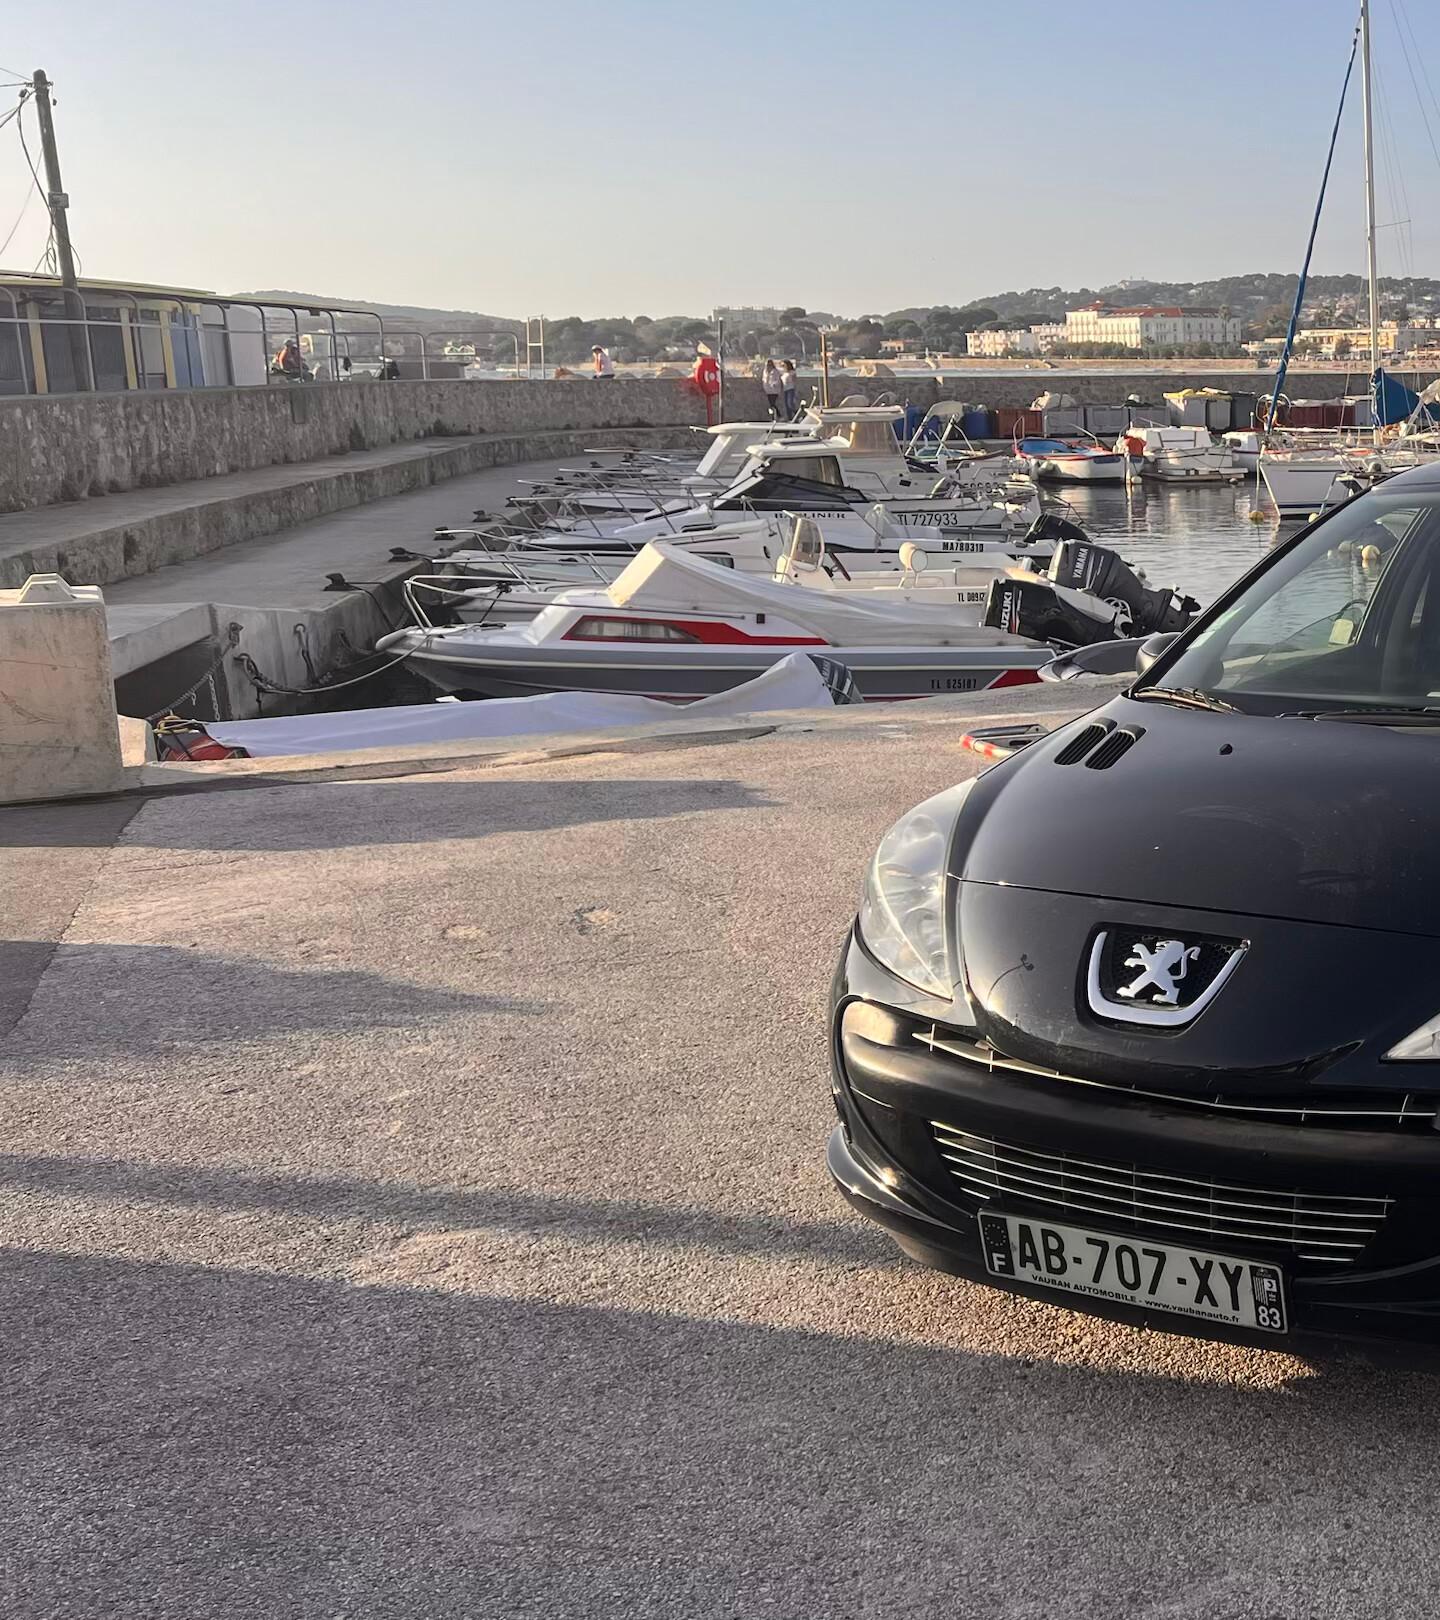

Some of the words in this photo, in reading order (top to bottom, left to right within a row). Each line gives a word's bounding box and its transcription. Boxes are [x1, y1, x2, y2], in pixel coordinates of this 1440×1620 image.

[1072, 547, 1089, 579] YAMAHA
[992, 1252, 1006, 1272] F
[1018, 1223, 1244, 1311] AB-707-XY
[1031, 1274, 1071, 1289] VAUBAN
[1073, 1284, 1137, 1303] AUTOMOBILE
[1145, 1299, 1241, 1323] www.vaubanauto.fr
[1258, 1305, 1281, 1329] 83
